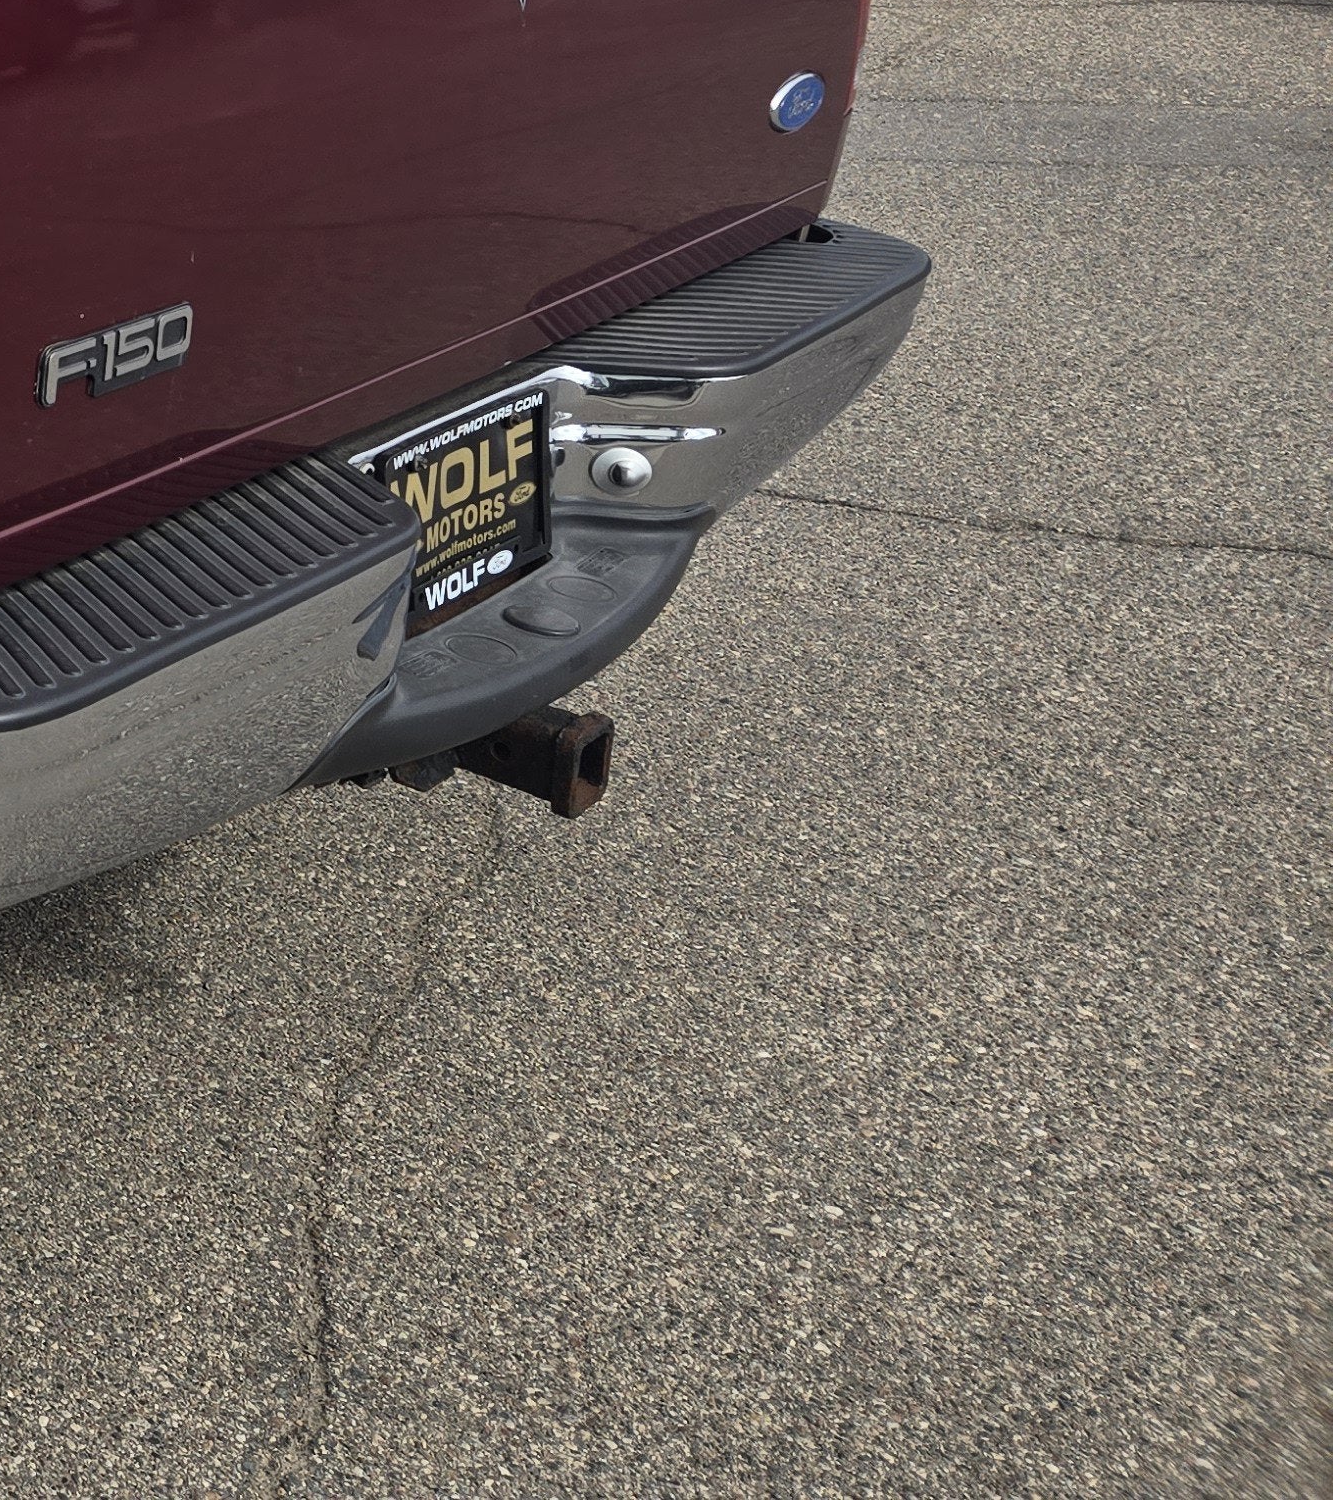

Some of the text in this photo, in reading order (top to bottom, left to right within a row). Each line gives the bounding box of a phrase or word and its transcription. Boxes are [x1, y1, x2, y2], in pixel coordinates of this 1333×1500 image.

[393, 392, 544, 470] WWW.WOLFMOTORSCOM
[390, 418, 533, 524] WOLF
[415, 518, 517, 578] www.wolfmotors.com
[426, 492, 506, 554] MOTORS
[424, 558, 486, 611] WOLF
